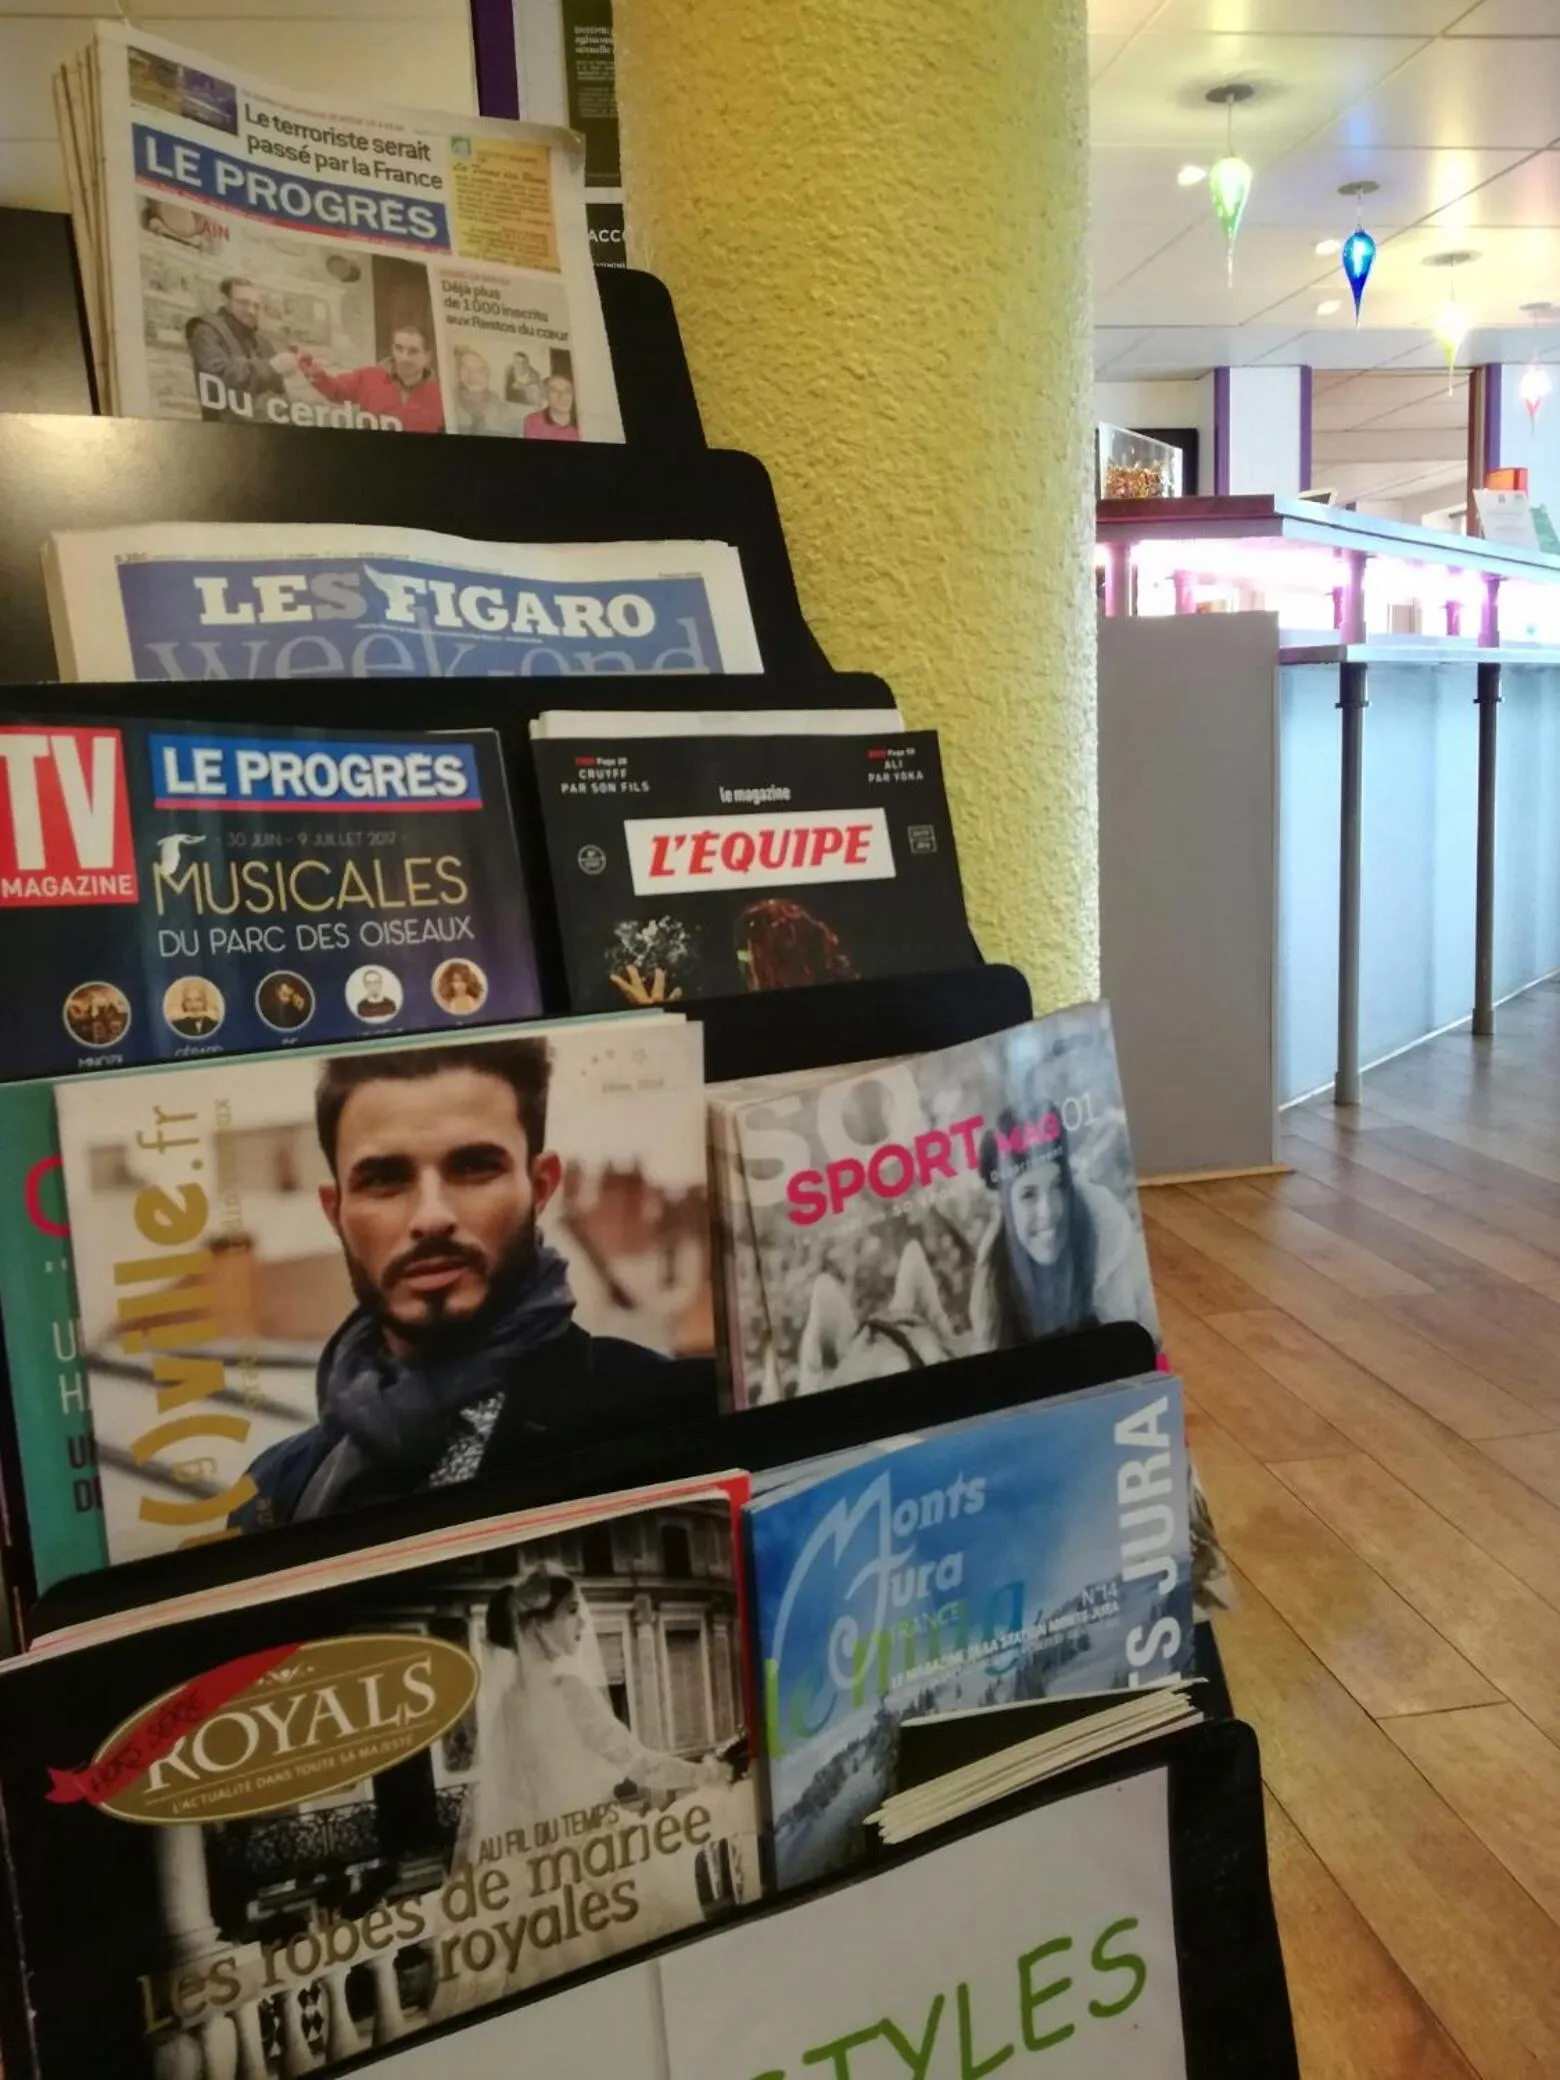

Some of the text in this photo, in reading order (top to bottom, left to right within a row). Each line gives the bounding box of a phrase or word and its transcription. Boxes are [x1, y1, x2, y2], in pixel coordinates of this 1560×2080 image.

[244, 102, 270, 127] Le
[272, 113, 370, 151] terroriste
[371, 134, 432, 163] serait
[144, 136, 202, 188] LE
[246, 133, 444, 191] passé par la France
[200, 219, 230, 242] AIN
[588, 228, 626, 243] ACC
[441, 278, 501, 300] Déjà plus
[500, 304, 550, 323] inscrits
[518, 321, 535, 337] du
[200, 371, 253, 419] Du
[363, 562, 657, 639] FIGARO
[162, 746, 228, 796] LE
[560, 780, 650, 795] PAR SON FILS
[719, 785, 792, 806] le magazine
[867, 772, 891, 783] PAR
[0, 734, 117, 871] TV
[228, 831, 247, 848] 30
[251, 831, 283, 848] JUIN
[296, 831, 308, 846] 9
[313, 830, 364, 848] JUILLET
[1, 874, 134, 899] MAGAZINE
[153, 854, 470, 917] MUSICALES
[158, 914, 476, 959] DU PARC DES OISEAUX
[742, 1063, 922, 1209] SO
[786, 1114, 985, 1227] SPORT
[993, 1110, 1062, 1156] MAG
[1061, 1092, 1101, 1132] 01
[1112, 1396, 1179, 1598] JURA
[255, 1769, 294, 1789] DANS
[295, 1758, 337, 1780] TOUTE
[478, 1800, 621, 1867] AU FIL DU TEMPS
[136, 1955, 242, 2036] Les
[259, 1892, 427, 1989] robes
[439, 1866, 512, 1925] de
[438, 1879, 641, 1984] royales
[747, 1916, 1147, 2080] TYLES
